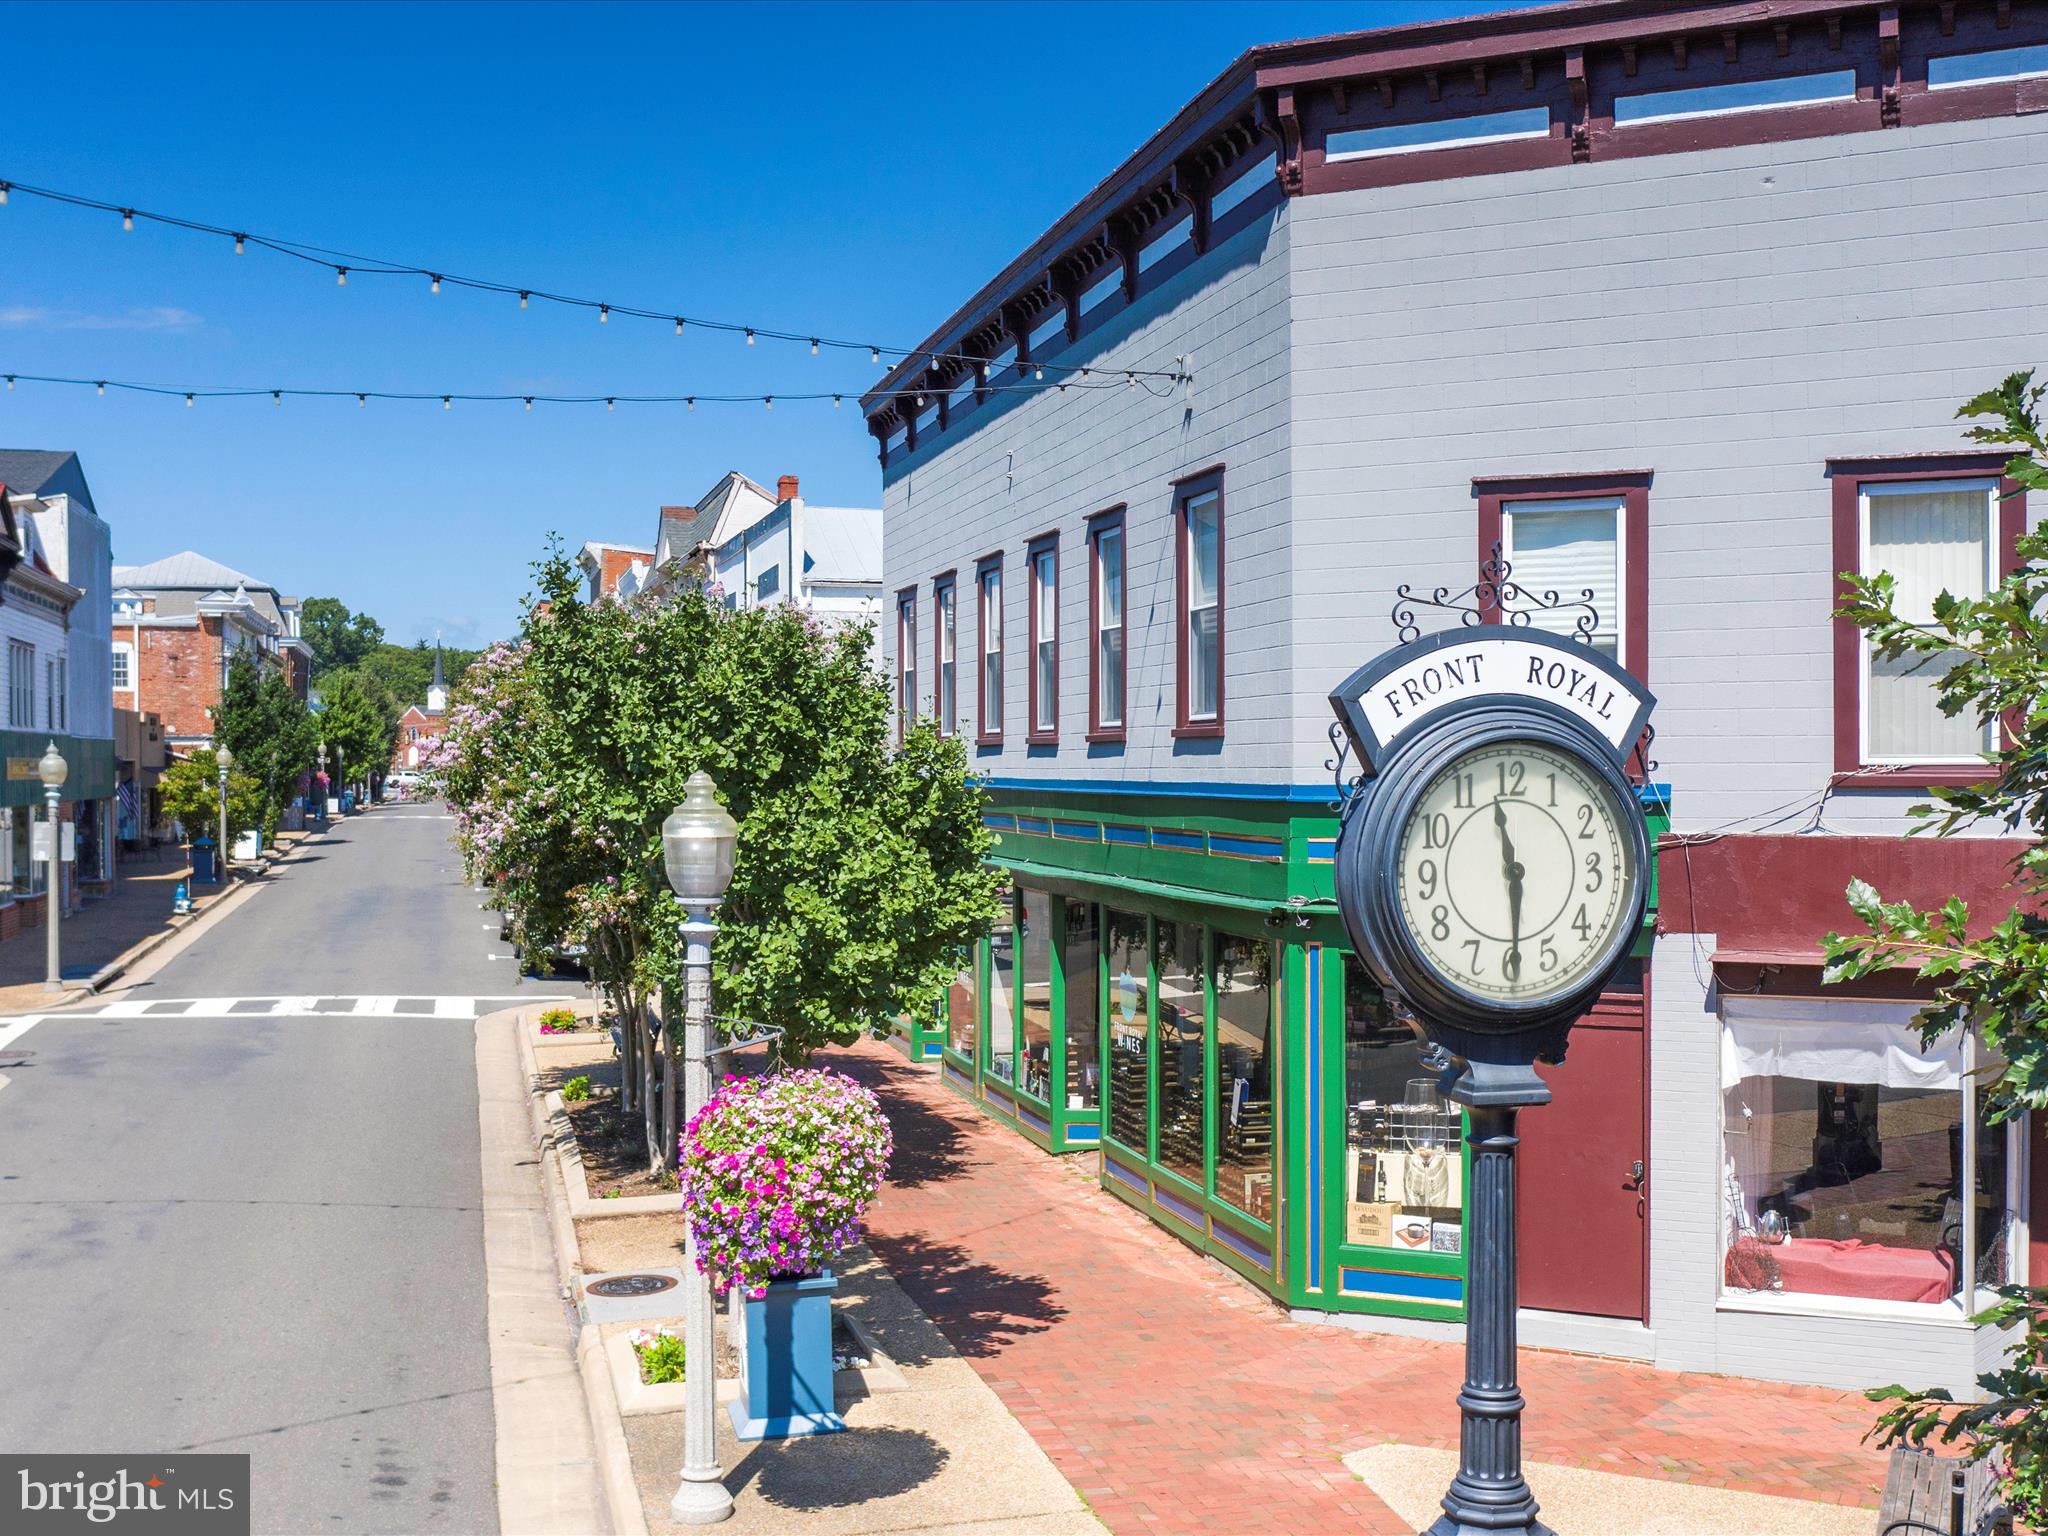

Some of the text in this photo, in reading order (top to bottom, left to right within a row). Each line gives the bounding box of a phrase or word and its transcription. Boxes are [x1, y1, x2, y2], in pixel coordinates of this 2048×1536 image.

[1385, 654, 1614, 721] FRONT ROYAL
[1452, 773, 1476, 809] 11
[1496, 760, 1528, 797] 12
[1546, 772, 1559, 807] 1
[1422, 812, 1450, 849] 10
[1578, 804, 1597, 839] 2
[1418, 859, 1438, 899] 9
[1585, 852, 1603, 893] 3
[1431, 905, 1450, 941] 8
[1571, 903, 1592, 941] 4
[1461, 939, 1485, 975] 7
[1539, 933, 1559, 972] 5
[1117, 1032, 1141, 1054] WINES
